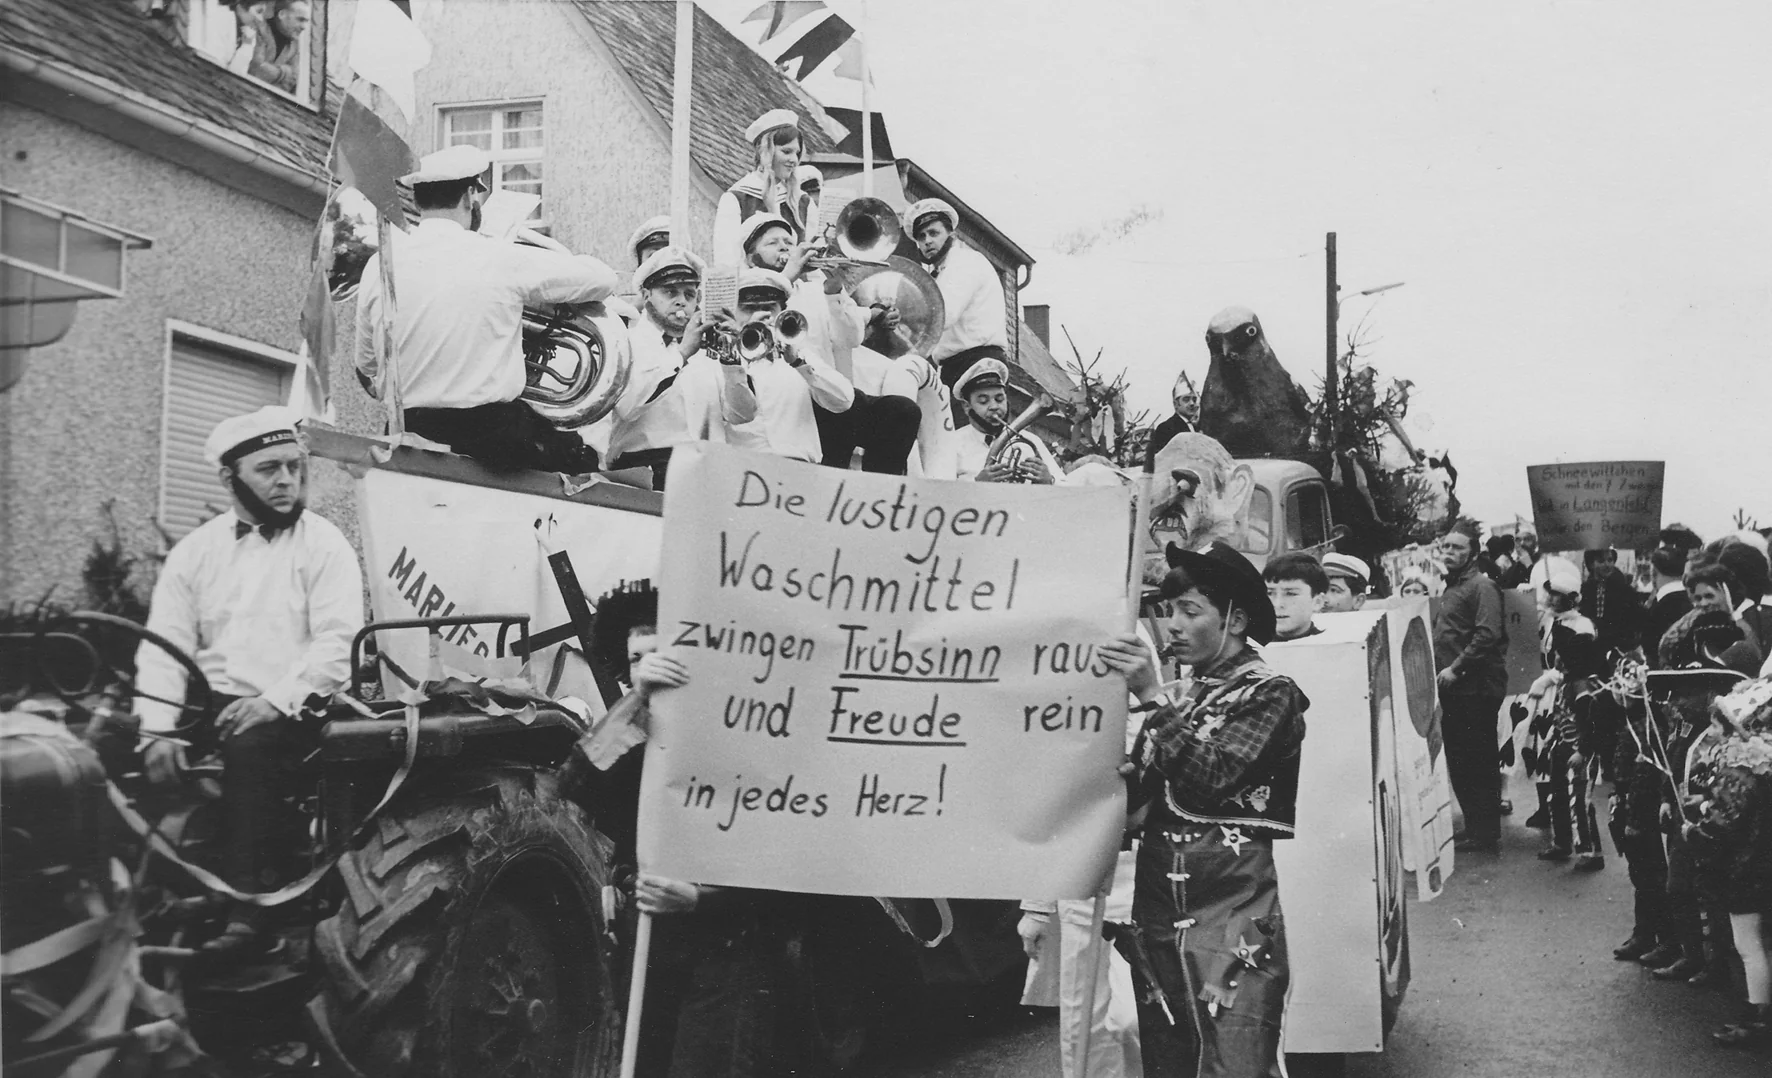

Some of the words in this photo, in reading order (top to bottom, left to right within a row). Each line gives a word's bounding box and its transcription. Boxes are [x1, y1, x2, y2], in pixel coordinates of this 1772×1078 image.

[736, 470, 806, 517] Die
[827, 480, 1010, 562] lustigen
[719, 530, 1019, 612] Waschmittel
[672, 621, 816, 683] zwingen
[839, 624, 1001, 680] Trübsinn
[723, 686, 796, 738] und
[828, 686, 963, 740] Freude
[1023, 696, 1104, 733] rein
[683, 777, 716, 807] in
[718, 774, 829, 831] jedes
[855, 763, 947, 817] Herz!
